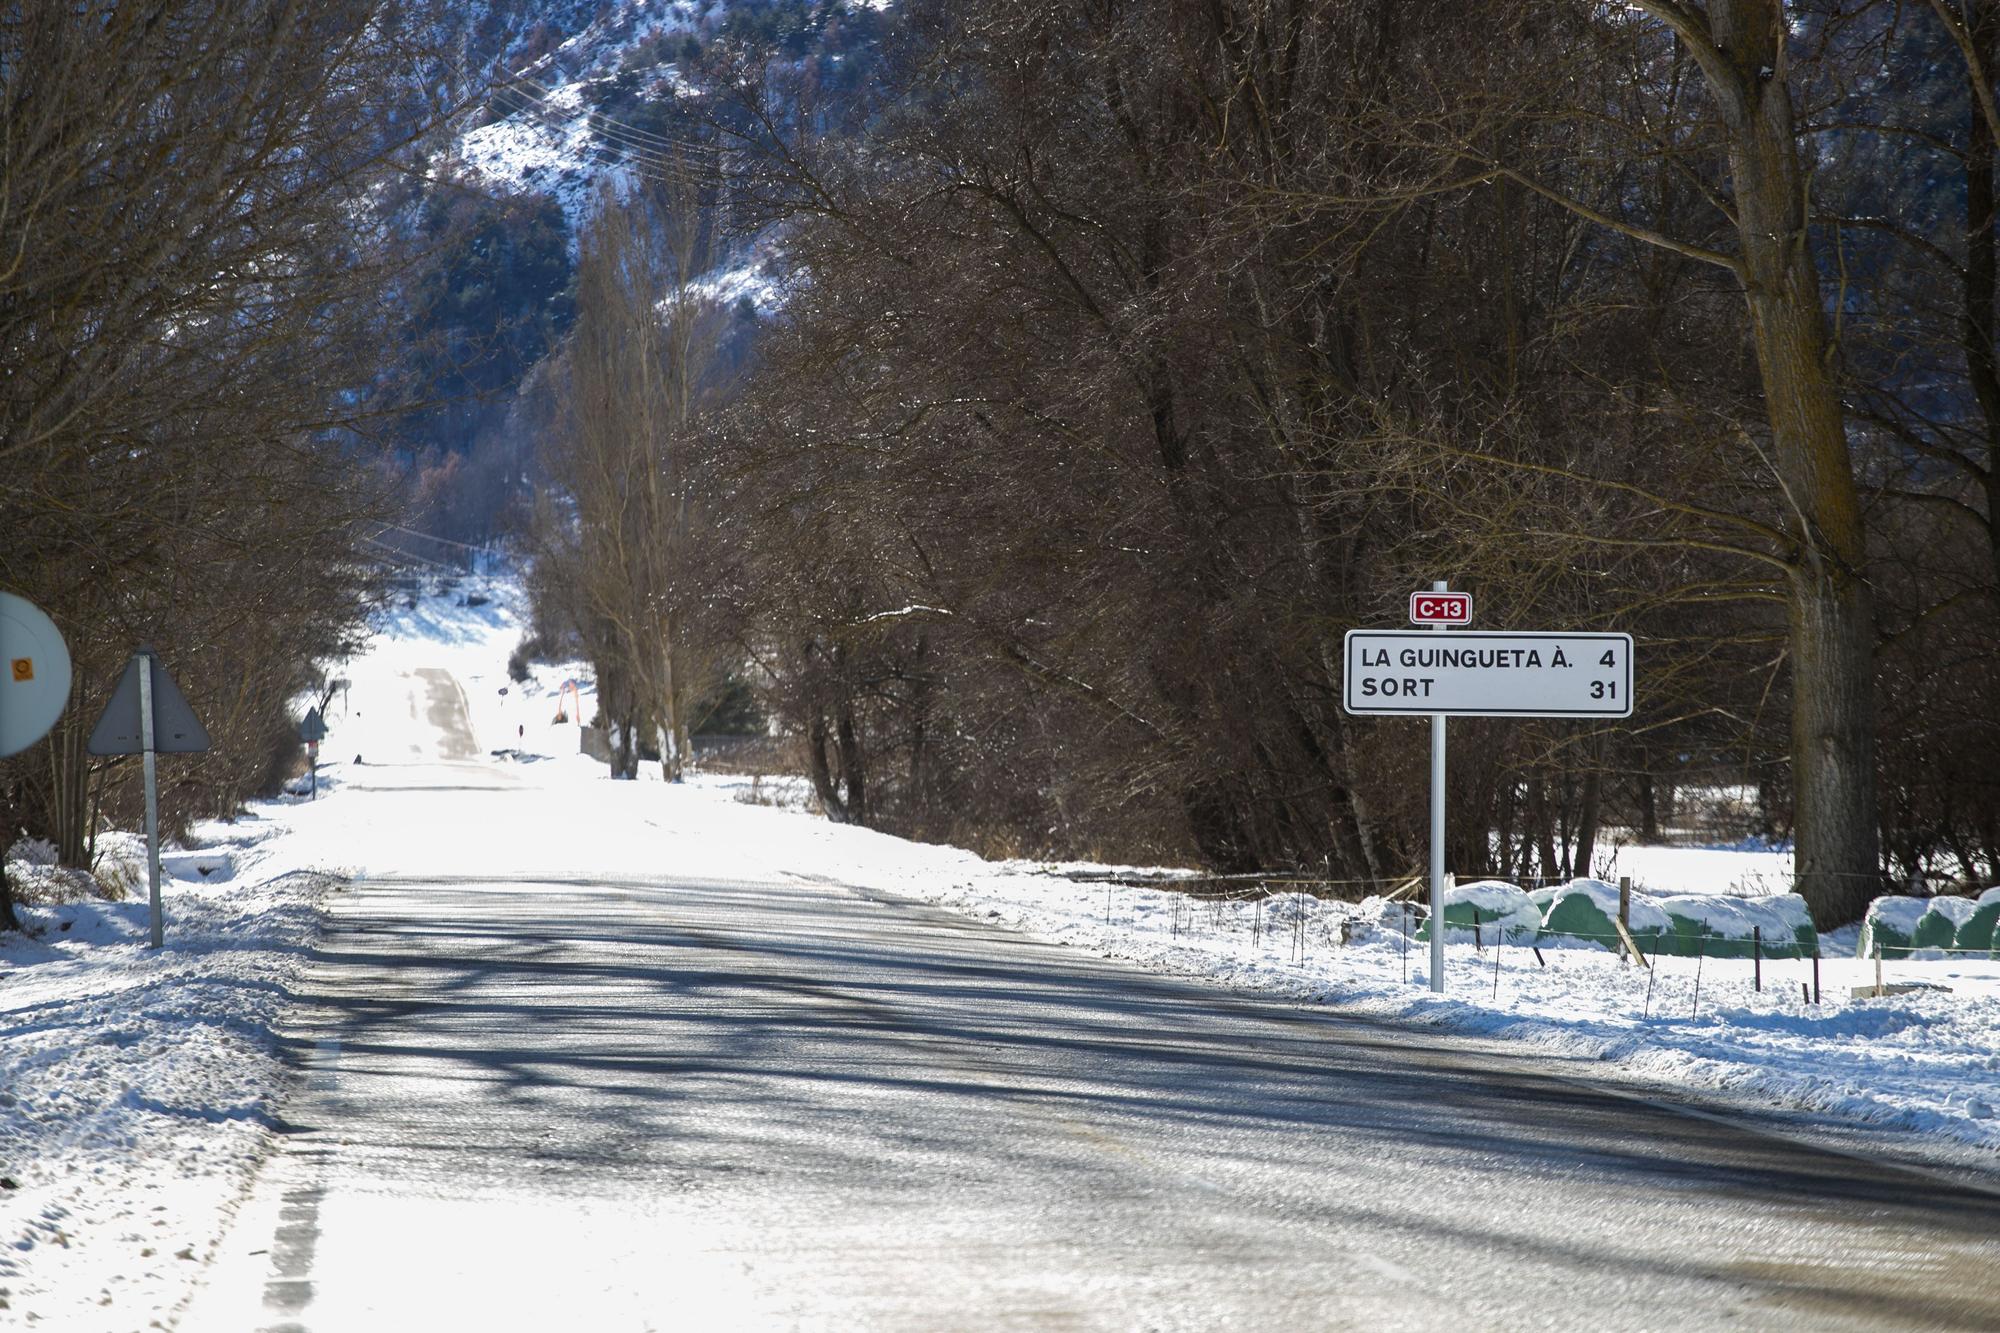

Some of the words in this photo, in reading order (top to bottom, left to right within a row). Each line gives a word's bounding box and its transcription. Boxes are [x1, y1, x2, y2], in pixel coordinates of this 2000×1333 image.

[1420, 600, 1462, 617] C-13
[1361, 649, 1391, 668] LA
[1400, 649, 1542, 668] GUINGUETA
[1551, 645, 1573, 668] À.
[1599, 649, 1616, 668] 4
[1361, 678, 1435, 697] SORT
[1590, 680, 1616, 699] 31
